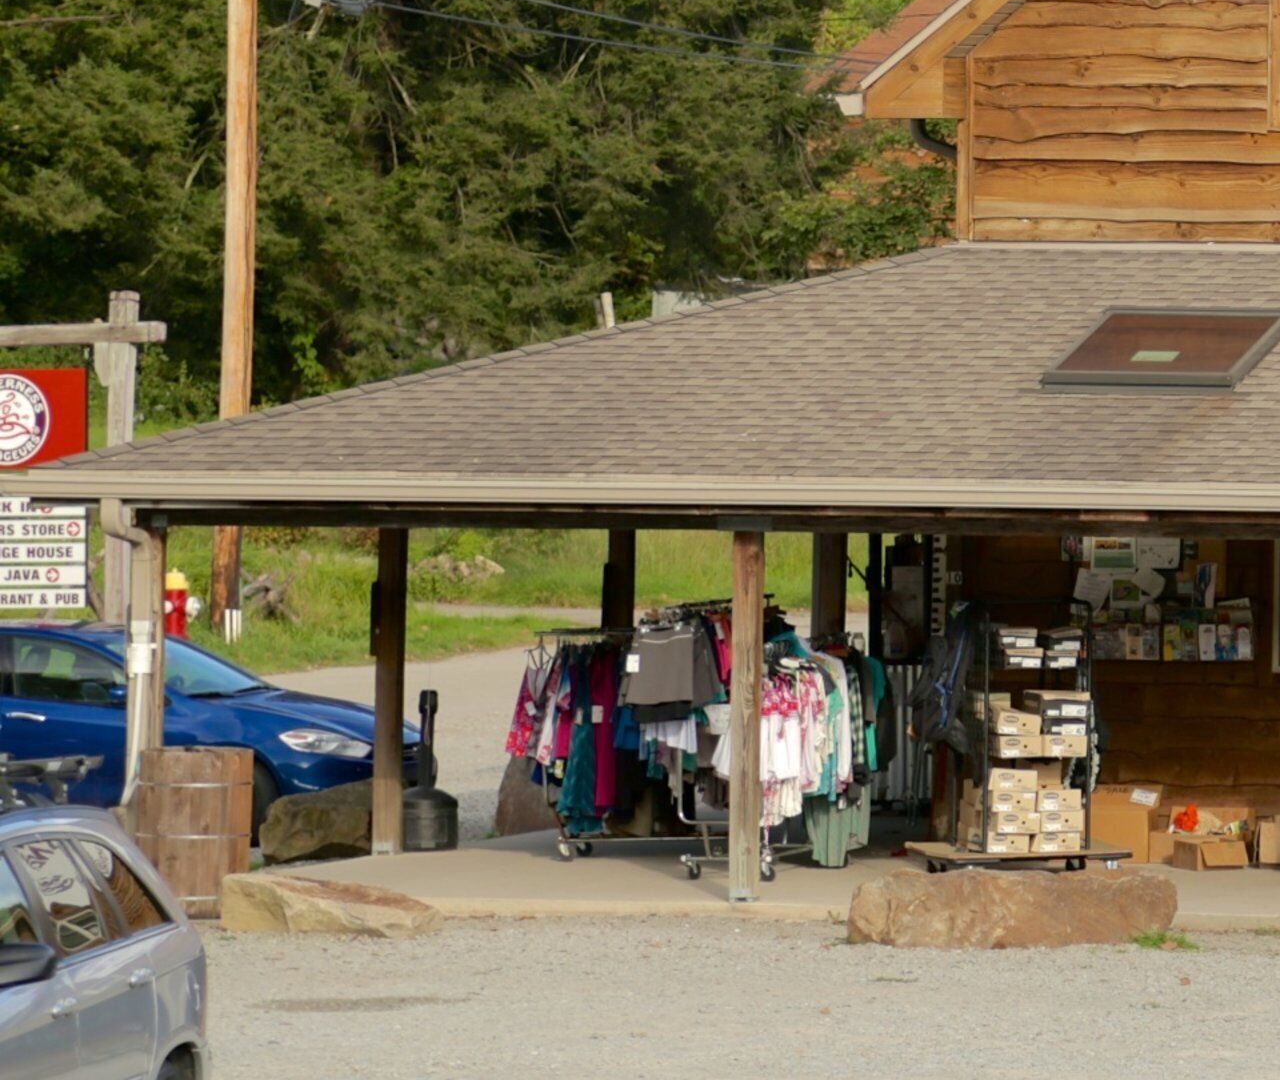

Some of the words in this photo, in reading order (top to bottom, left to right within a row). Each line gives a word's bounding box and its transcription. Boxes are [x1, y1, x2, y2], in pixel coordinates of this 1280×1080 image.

[22, 524, 65, 535] STORE
[26, 547, 73, 558] HOUSE
[4, 569, 40, 581] JAVA
[39, 593, 47, 604] &
[55, 593, 79, 605] PUB
